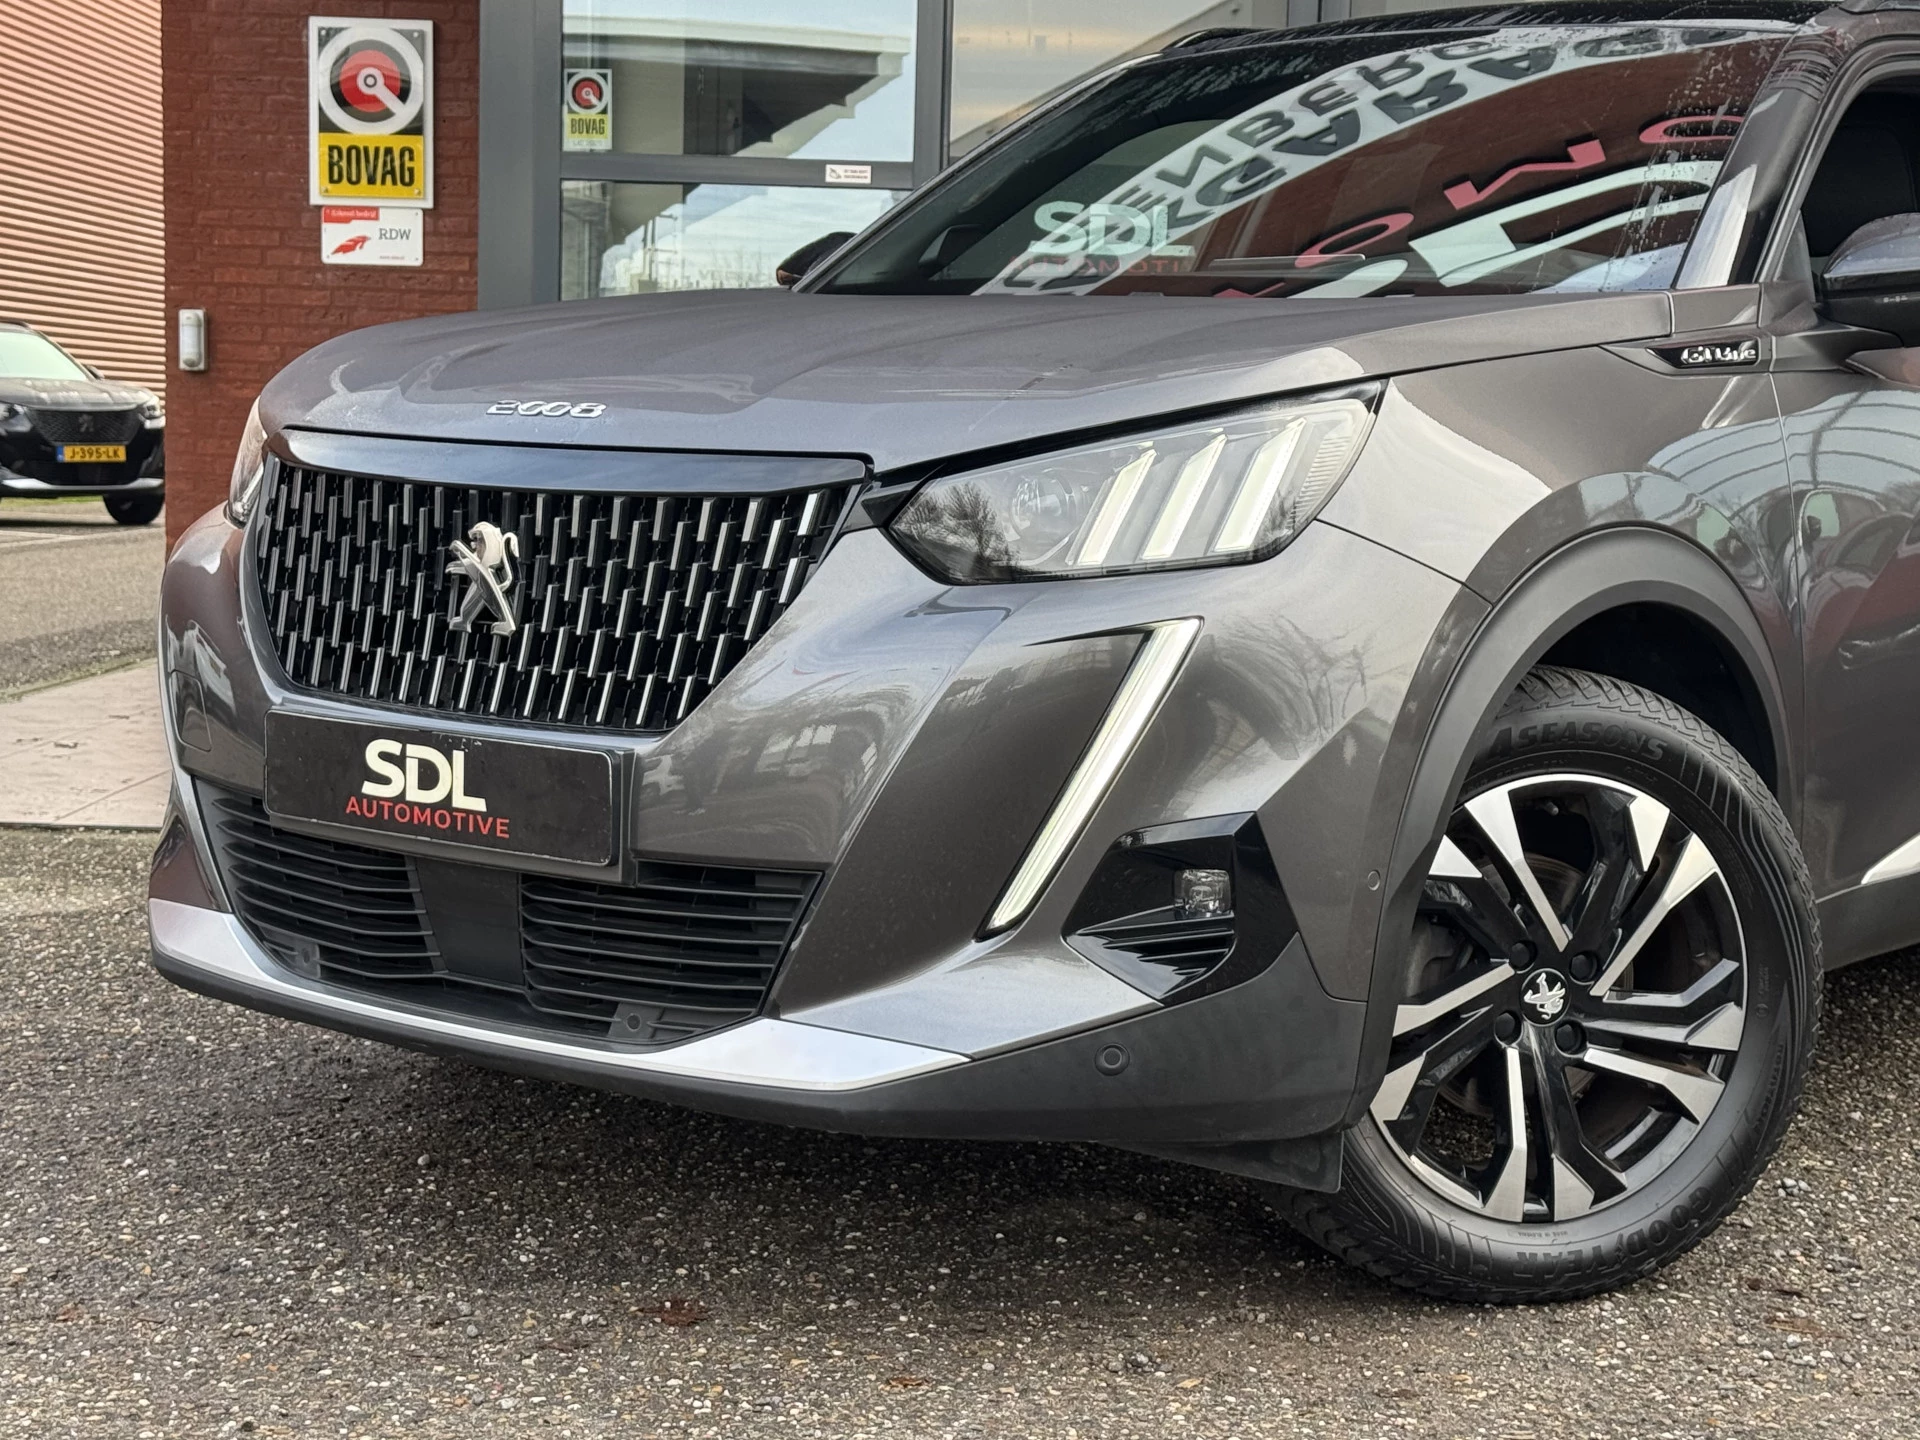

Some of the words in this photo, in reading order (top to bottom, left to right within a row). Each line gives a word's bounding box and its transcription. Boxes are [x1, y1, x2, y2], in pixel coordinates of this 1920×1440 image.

[570, 117, 605, 135] BOVAG
[327, 144, 416, 188] BOVAG
[378, 228, 412, 241] RDW
[1028, 200, 1195, 256] SDL
[486, 399, 607, 419] 2008
[69, 447, 121, 459] J-395-LK
[361, 738, 487, 812] SDL
[345, 795, 511, 839] AUTOMOTIVE
[1513, 1186, 1713, 1278] GOODYEAR
